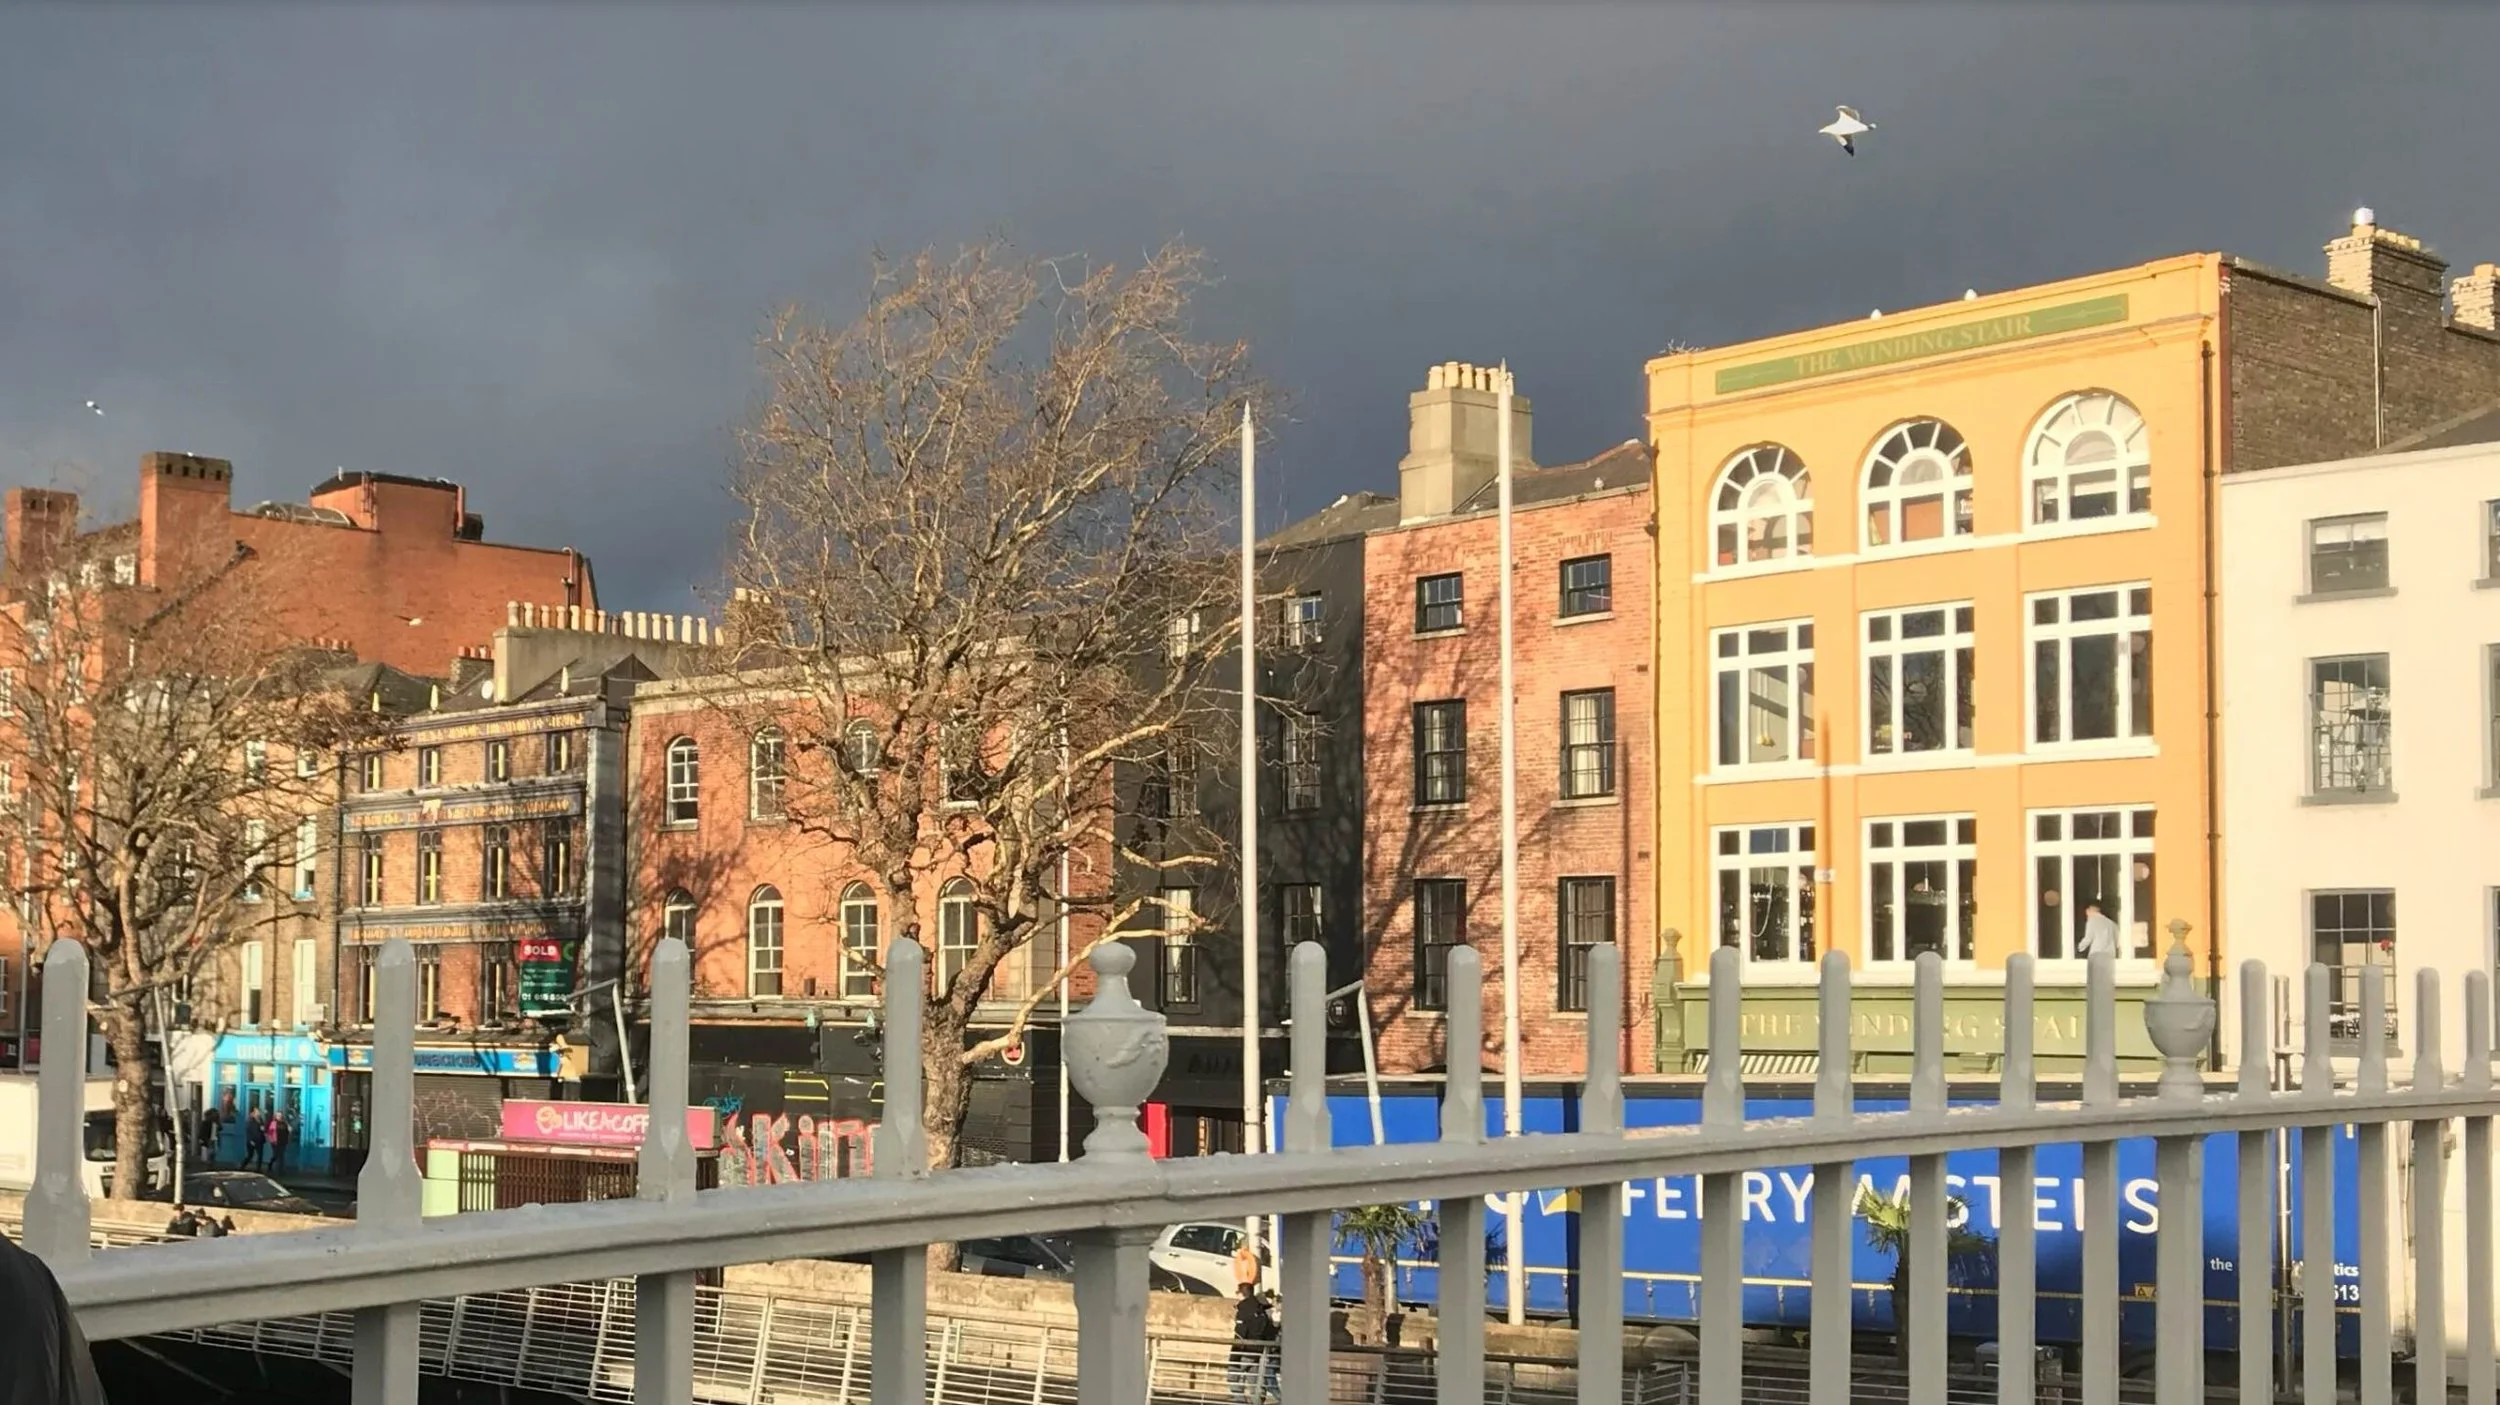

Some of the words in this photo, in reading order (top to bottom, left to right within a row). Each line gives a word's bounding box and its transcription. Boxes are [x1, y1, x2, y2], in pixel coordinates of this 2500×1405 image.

[1794, 350, 1840, 375] THE
[1848, 331, 1952, 363] WINDING
[1960, 315, 2032, 346] STAIR
[524, 944, 558, 956] SOLD
[1741, 1012, 1801, 1037] THE
[237, 1042, 289, 1060] unicef
[2209, 1257, 2233, 1272] the
